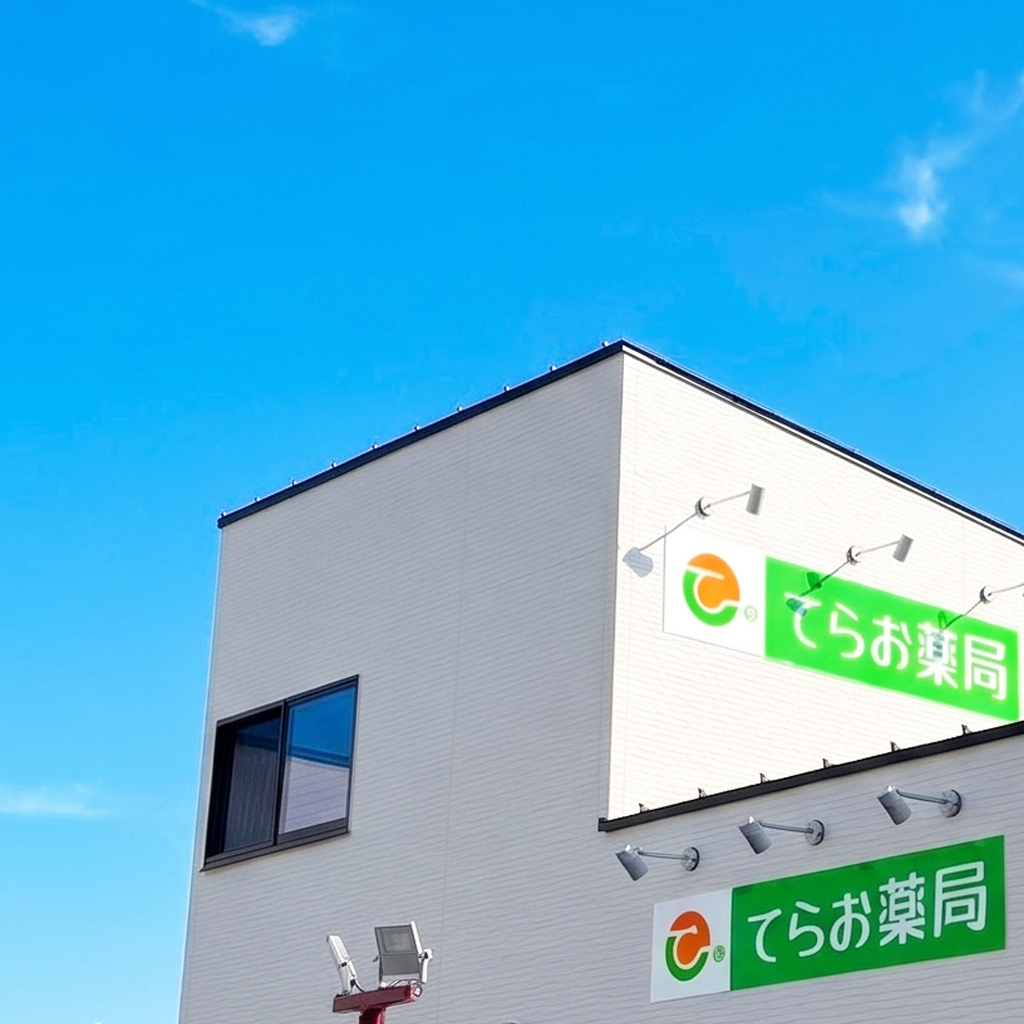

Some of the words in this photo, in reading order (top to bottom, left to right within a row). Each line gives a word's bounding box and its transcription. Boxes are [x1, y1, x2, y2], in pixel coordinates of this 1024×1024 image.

[784, 592, 1008, 701] てらお薬局
[747, 861, 989, 963] てらお薬局
